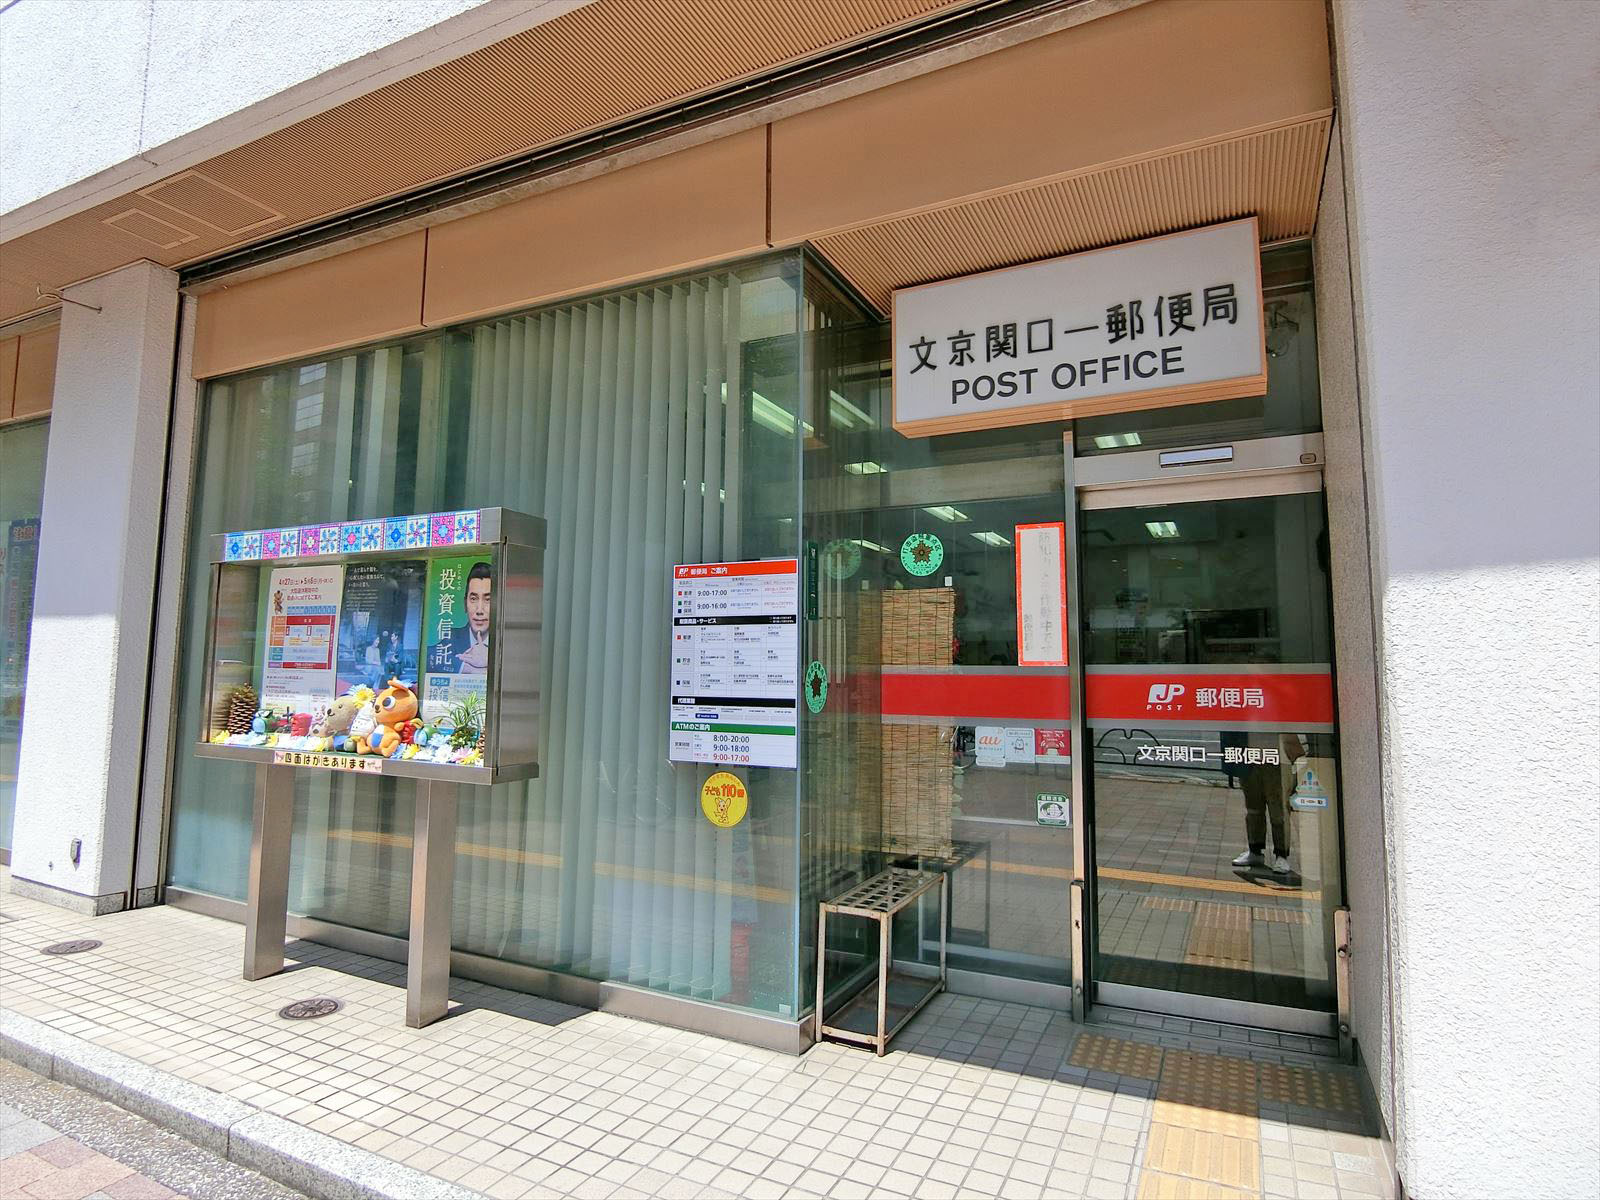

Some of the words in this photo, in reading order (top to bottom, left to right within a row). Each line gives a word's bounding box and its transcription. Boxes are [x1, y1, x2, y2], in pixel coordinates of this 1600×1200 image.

[908, 283, 1238, 375] 文京関口一郵便局
[951, 367, 1039, 405] POST
[1051, 345, 1185, 390] OFFICE
[697, 589, 728, 597] 9:00-17:00
[435, 568, 457, 665] 投資信託
[429, 687, 449, 702] 投信
[1194, 687, 1266, 710] 郵便局
[713, 734, 750, 743] 8:00-20:00
[979, 735, 1002, 746] au
[713, 744, 750, 753] 9:00-18:00
[1136, 743, 1280, 767] 文京関口一郵便局
[713, 753, 750, 763] 9:00-17:00
